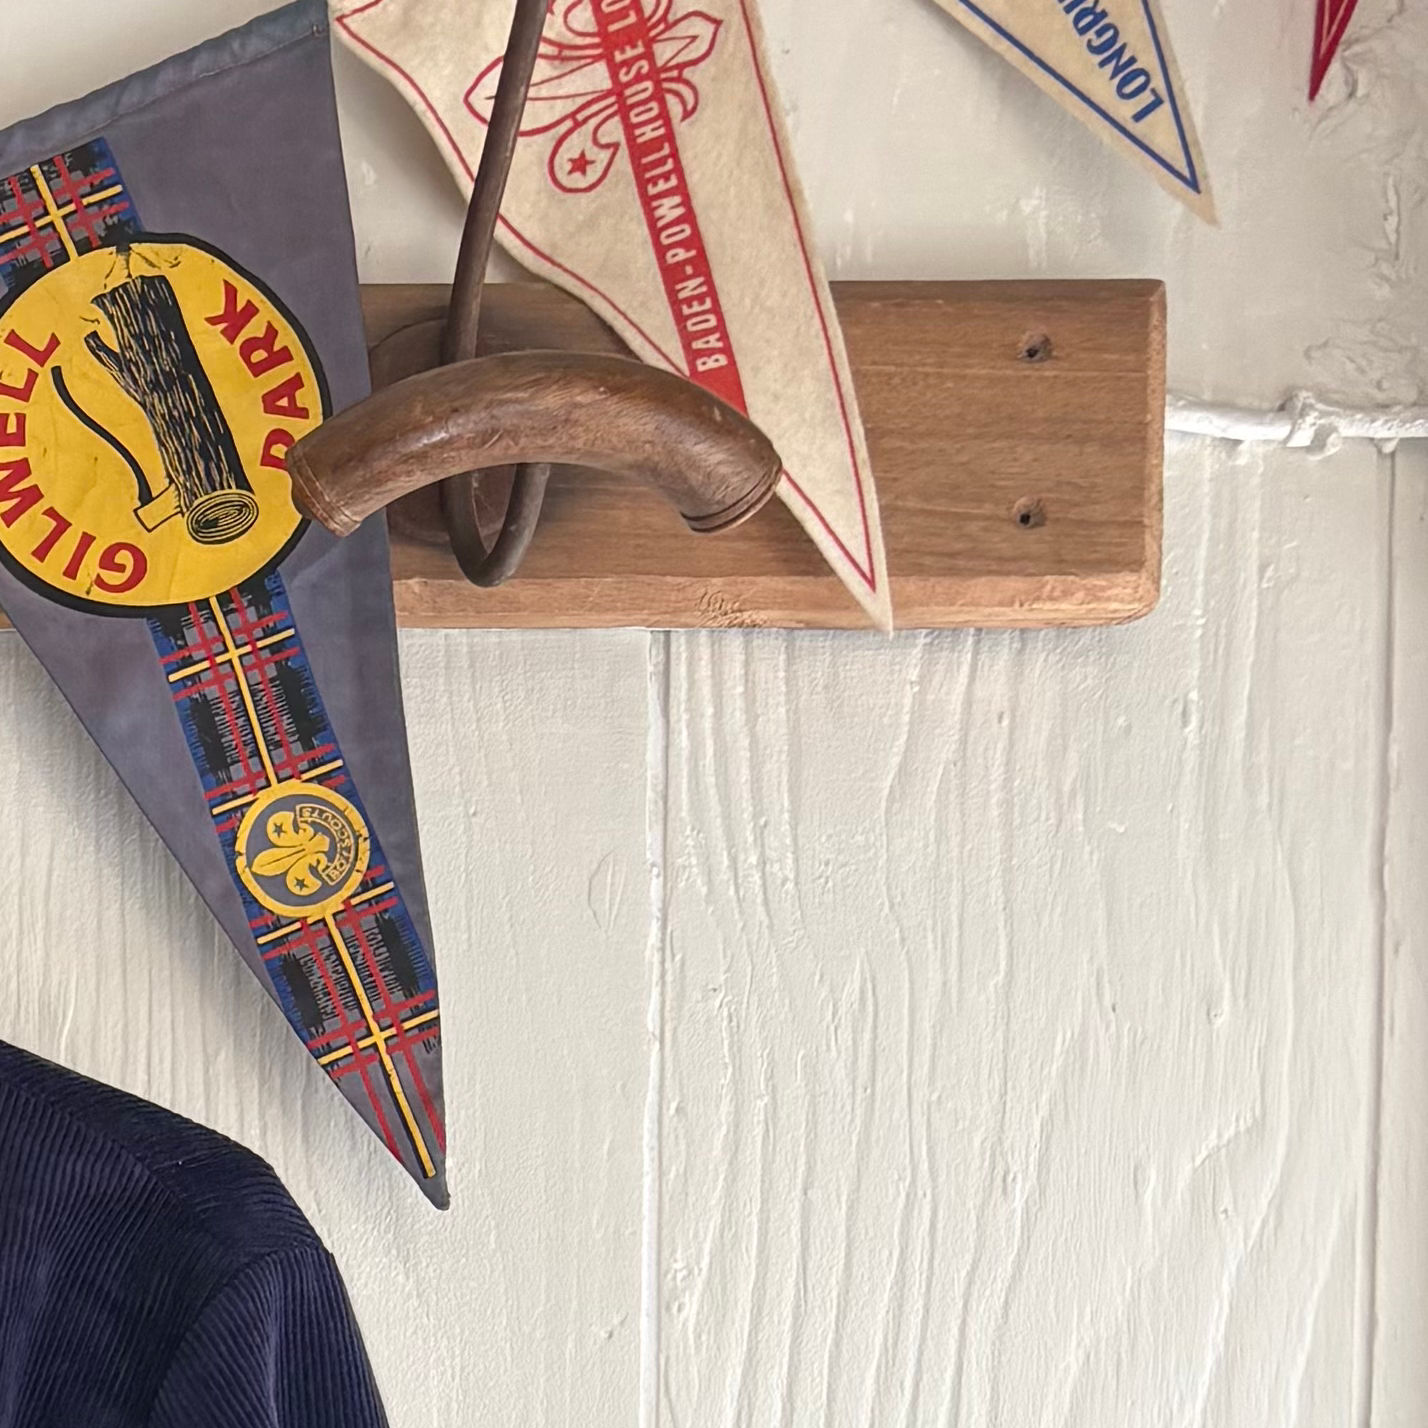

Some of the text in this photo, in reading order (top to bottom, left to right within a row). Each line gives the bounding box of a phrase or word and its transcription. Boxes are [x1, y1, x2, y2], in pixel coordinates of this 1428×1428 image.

[612, 39, 666, 144] HOUSE
[1057, 0, 1164, 123] LONGRI
[206, 278, 310, 472] PARK
[300, 806, 352, 850] SCOUTS
